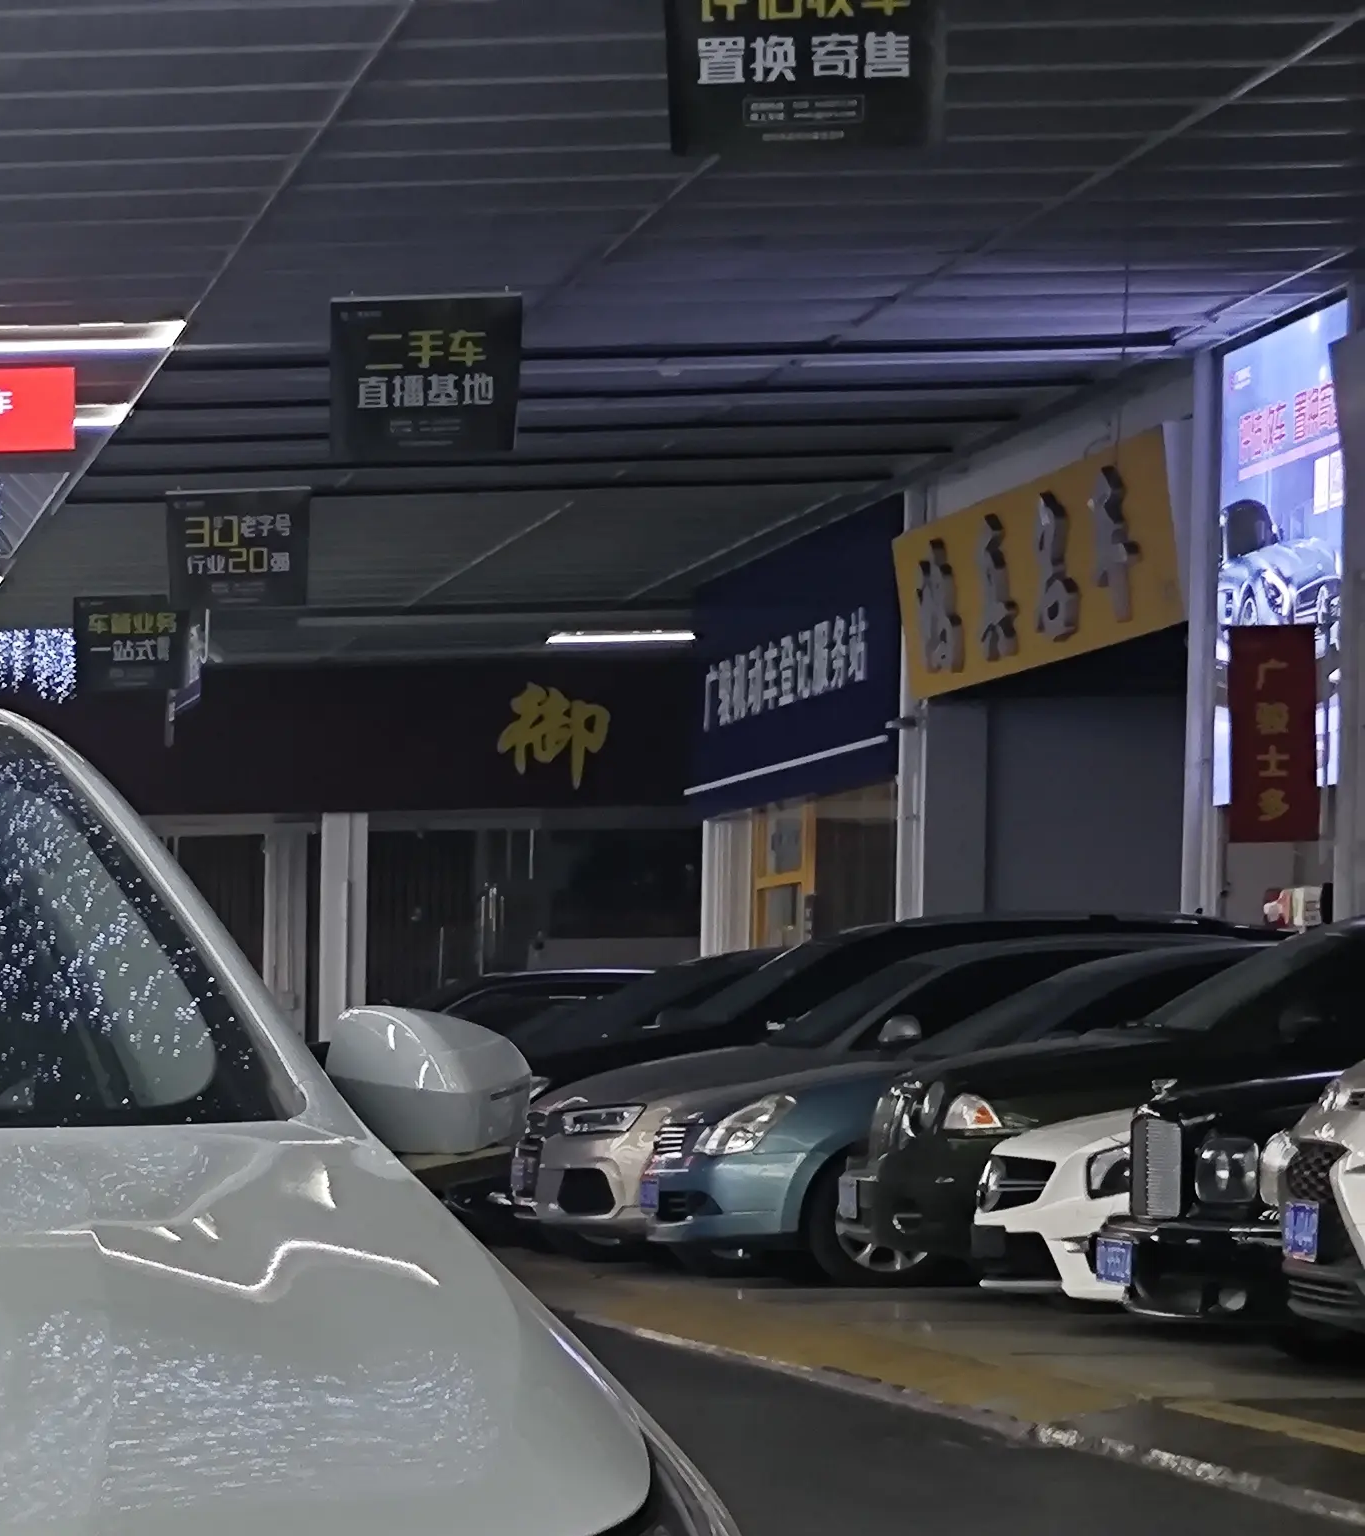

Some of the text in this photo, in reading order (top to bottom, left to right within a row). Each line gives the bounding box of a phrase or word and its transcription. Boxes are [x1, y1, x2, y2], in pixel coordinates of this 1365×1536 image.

[697, 31, 910, 84] 置换寄售
[365, 330, 486, 369] 二手车
[357, 372, 494, 408] 直播基地
